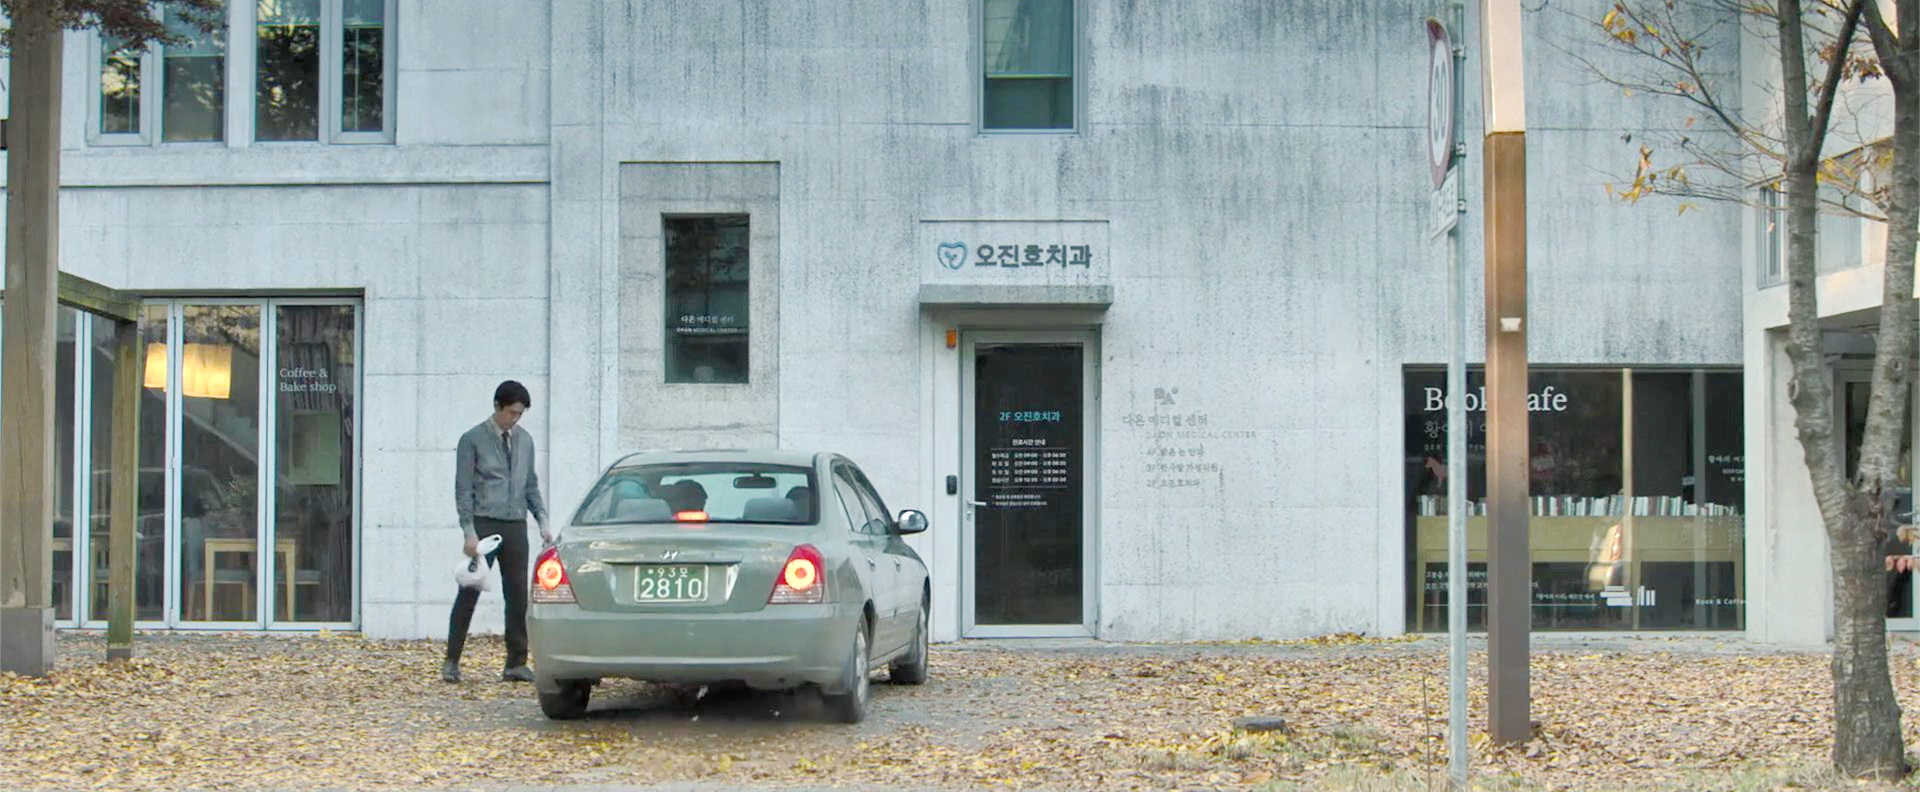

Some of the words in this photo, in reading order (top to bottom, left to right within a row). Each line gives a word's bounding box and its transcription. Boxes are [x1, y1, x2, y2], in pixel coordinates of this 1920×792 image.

[974, 244, 1093, 268] 오진호치과
[280, 367, 316, 378] Coffee
[319, 368, 328, 378] &
[280, 381, 307, 392] Bake
[310, 381, 337, 394] shop
[1423, 386, 1487, 411] Bo
[1527, 386, 1568, 412] afe
[1000, 412, 1011, 421] 2F
[1014, 411, 1060, 422] 오진호치과
[1122, 413, 1145, 427] 다온
[1186, 413, 1208, 427] 센터
[1221, 430, 1257, 439] CENTER
[657, 567, 688, 578] 93모
[640, 578, 702, 598] 2810
